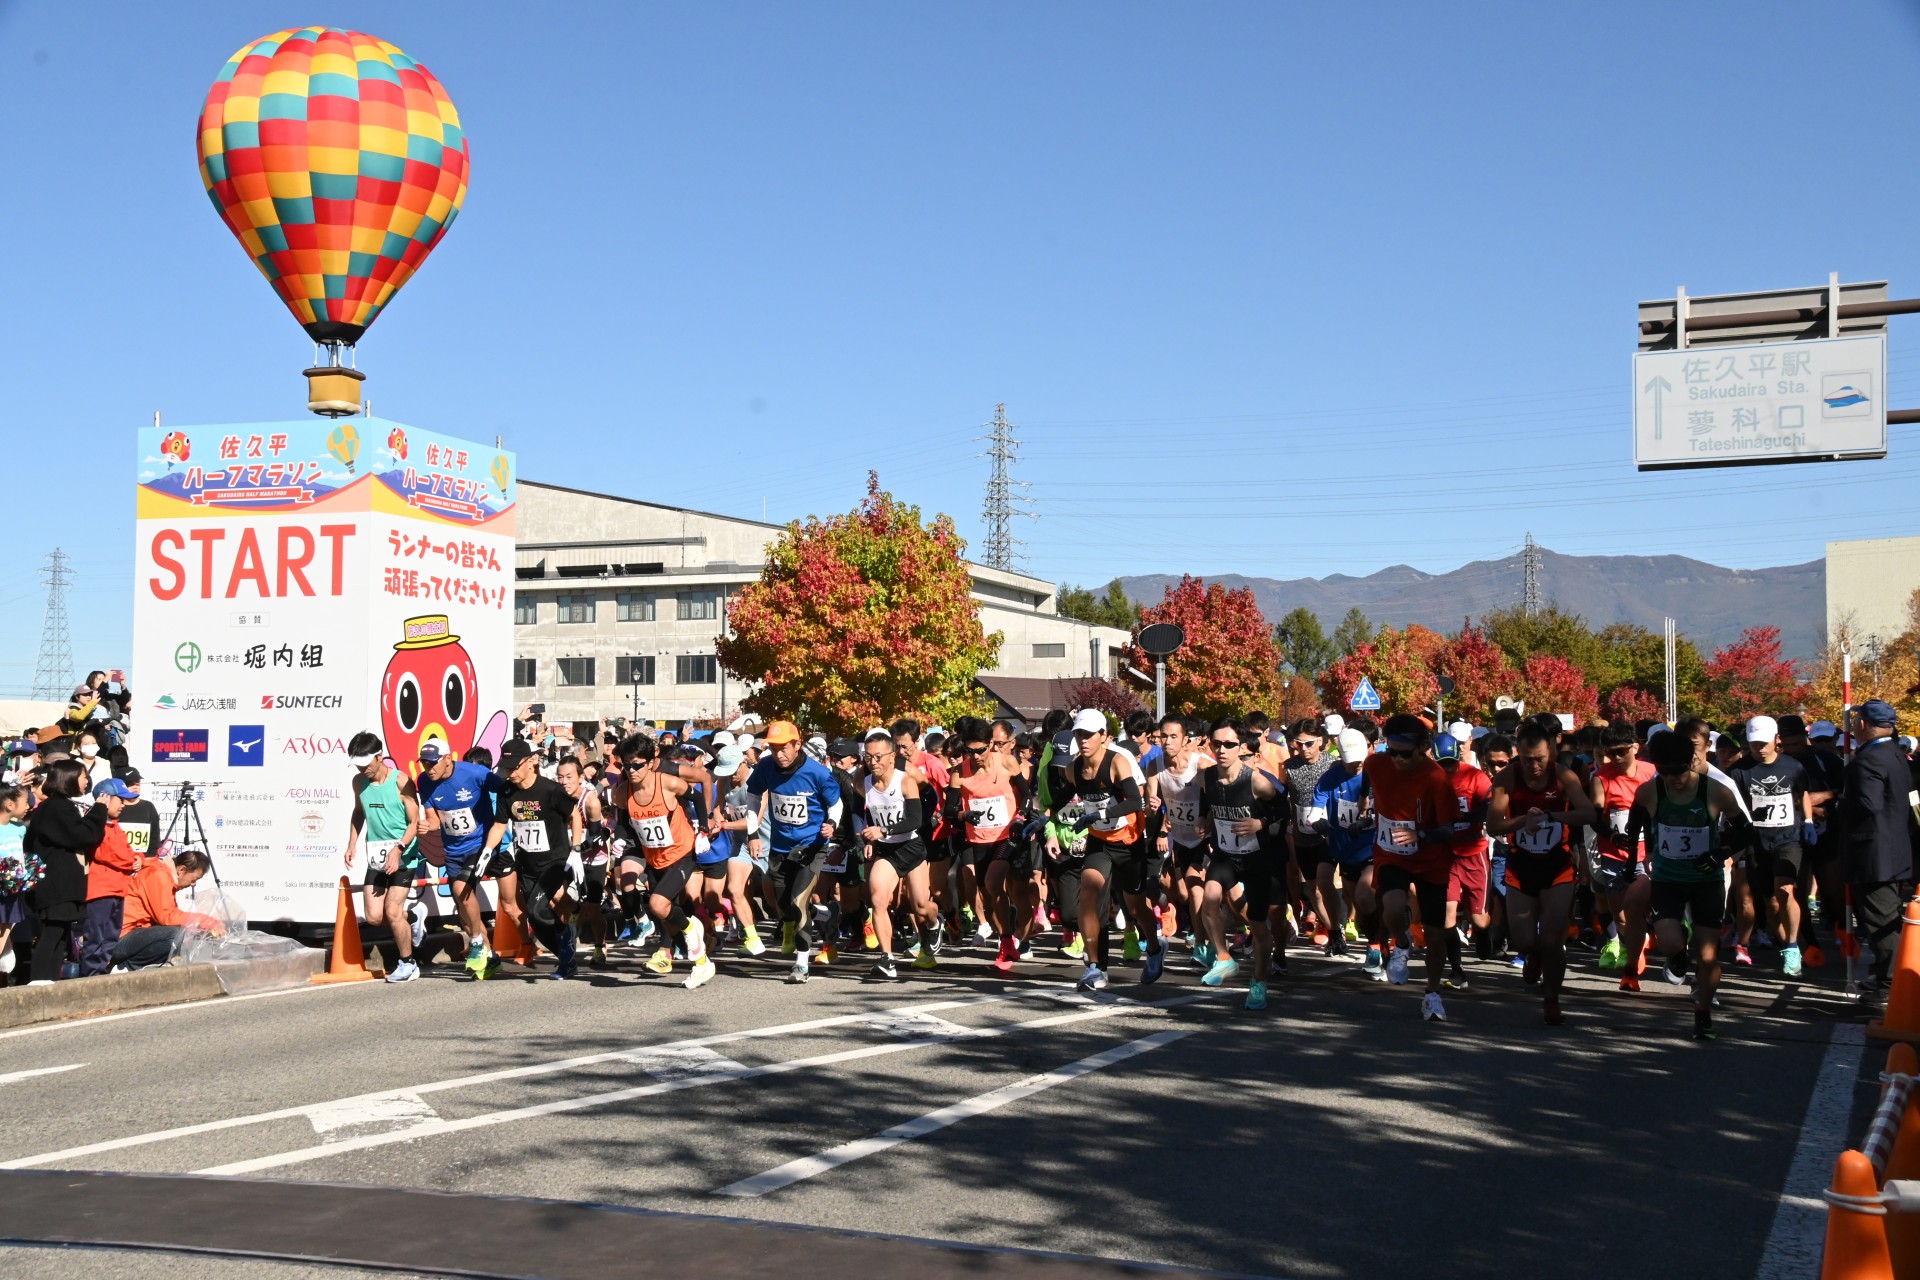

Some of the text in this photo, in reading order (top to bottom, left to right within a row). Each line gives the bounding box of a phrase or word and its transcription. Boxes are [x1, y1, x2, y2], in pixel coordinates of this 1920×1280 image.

[1682, 350, 1811, 384] 佐久平駅
[1689, 380, 1809, 401] Sakudaira Sta.
[1686, 405, 1804, 435] 蓼科口
[220, 434, 288, 459] 佐久平
[1689, 433, 1806, 452] Tateshinaguchi
[426, 443, 469, 471] 佐久平
[183, 461, 323, 489] ハーフマラソン
[403, 467, 489, 504] ハーフマラソン
[149, 524, 356, 601] START
[388, 529, 502, 572] ランナーの皆さん
[207, 642, 324, 669] 株式会社 堀内組
[276, 695, 343, 709] SUNTECH
[154, 742, 184, 752] SPORTS
[282, 733, 347, 760] ARSOA
[313, 788, 341, 799] MALL
